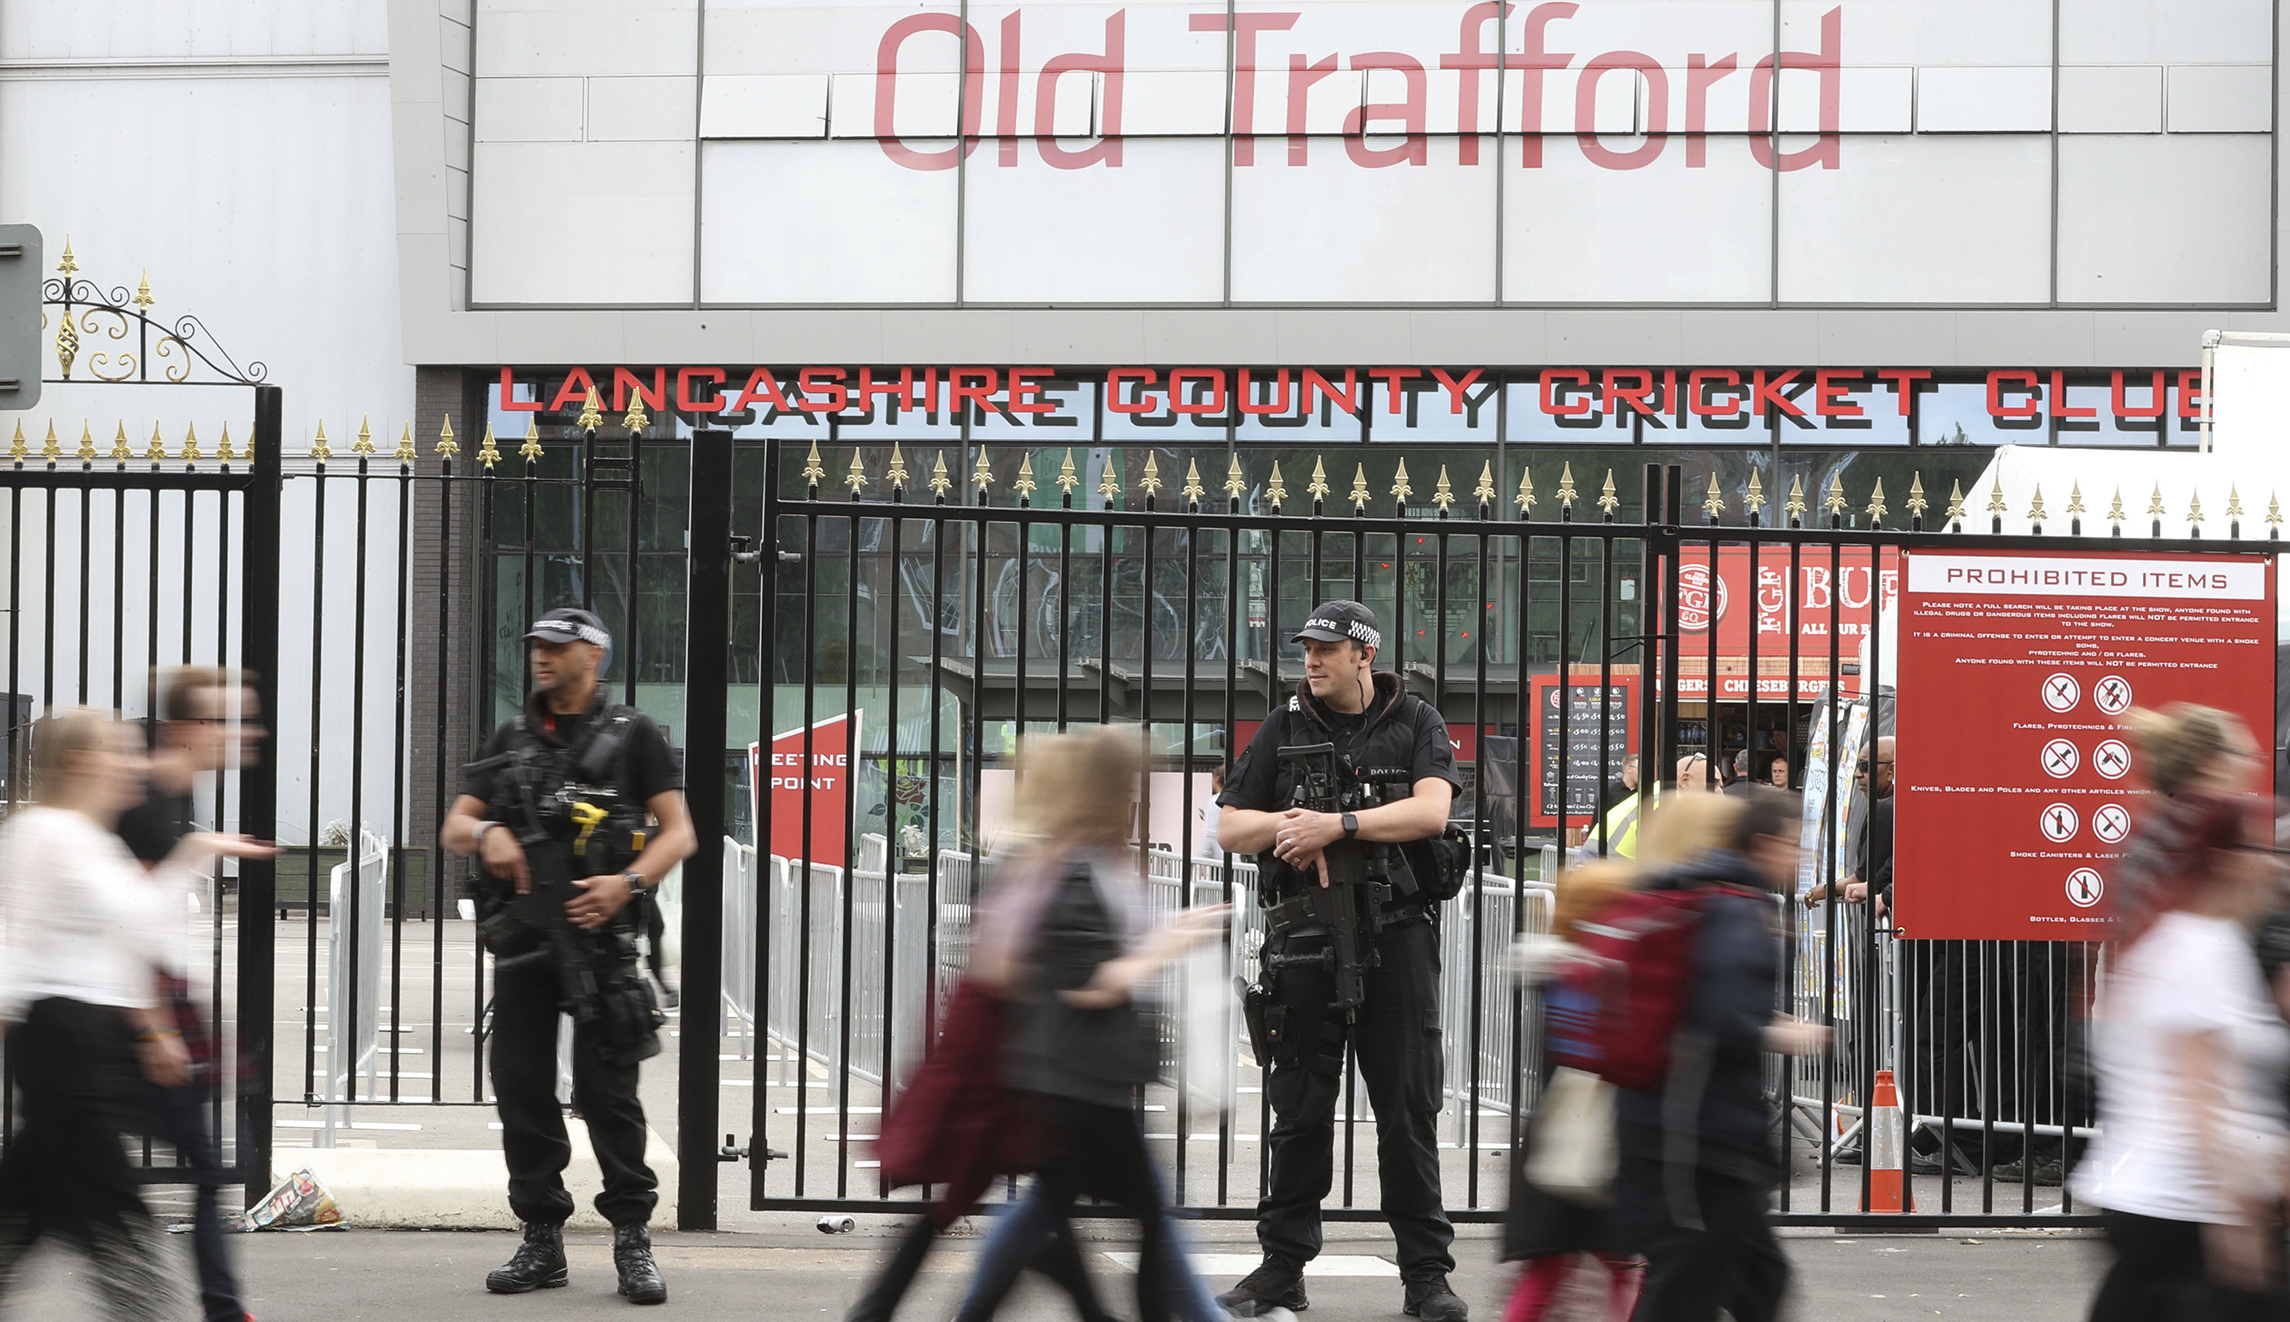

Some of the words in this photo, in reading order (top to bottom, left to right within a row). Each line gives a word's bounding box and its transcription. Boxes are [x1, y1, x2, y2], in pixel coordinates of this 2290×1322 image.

[873, 8, 1125, 171] Old
[1189, 1, 1842, 172] Trafford
[500, 366, 1056, 413] LANCASHIRE
[1107, 367, 1485, 415] COUNTY
[1539, 368, 1932, 416] CRICKET
[1947, 568, 2128, 587] PROHIBITED
[2142, 572, 2228, 589] ITEMS
[2149, 606, 2172, 614] SHOW,
[1304, 618, 1338, 630] POLICE
[1801, 623, 1828, 635] ALL
[1835, 623, 1859, 635] UR
[2076, 642, 2099, 650] BOMB,
[2013, 722, 2045, 730] FLARES,
[2047, 723, 2105, 731] PYROTECHNICS
[1911, 785, 1942, 793] KNIVES,
[1945, 785, 1975, 793] BLADES
[2040, 851, 2083, 859] CANISTERS
